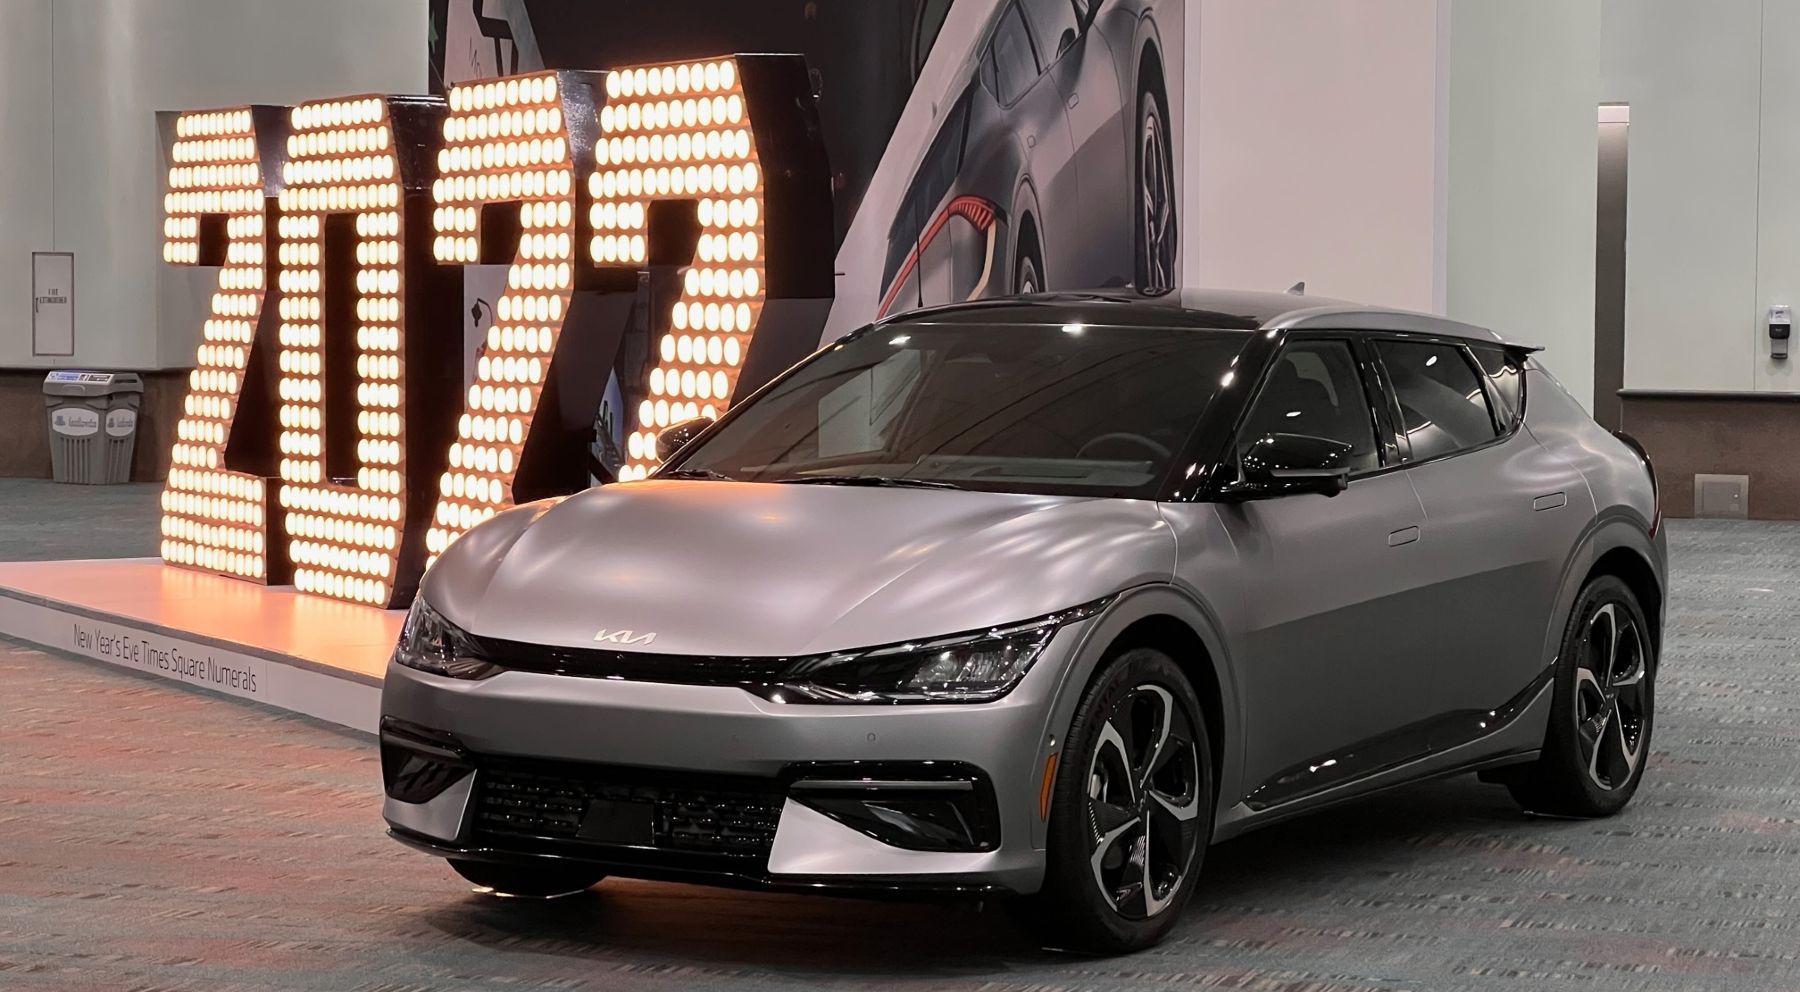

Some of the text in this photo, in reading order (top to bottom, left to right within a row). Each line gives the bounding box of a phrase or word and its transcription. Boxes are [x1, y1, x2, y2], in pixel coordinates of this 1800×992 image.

[73, 624, 257, 692] New Year's Eve Times Square Numerals
[594, 628, 657, 646] KIA
